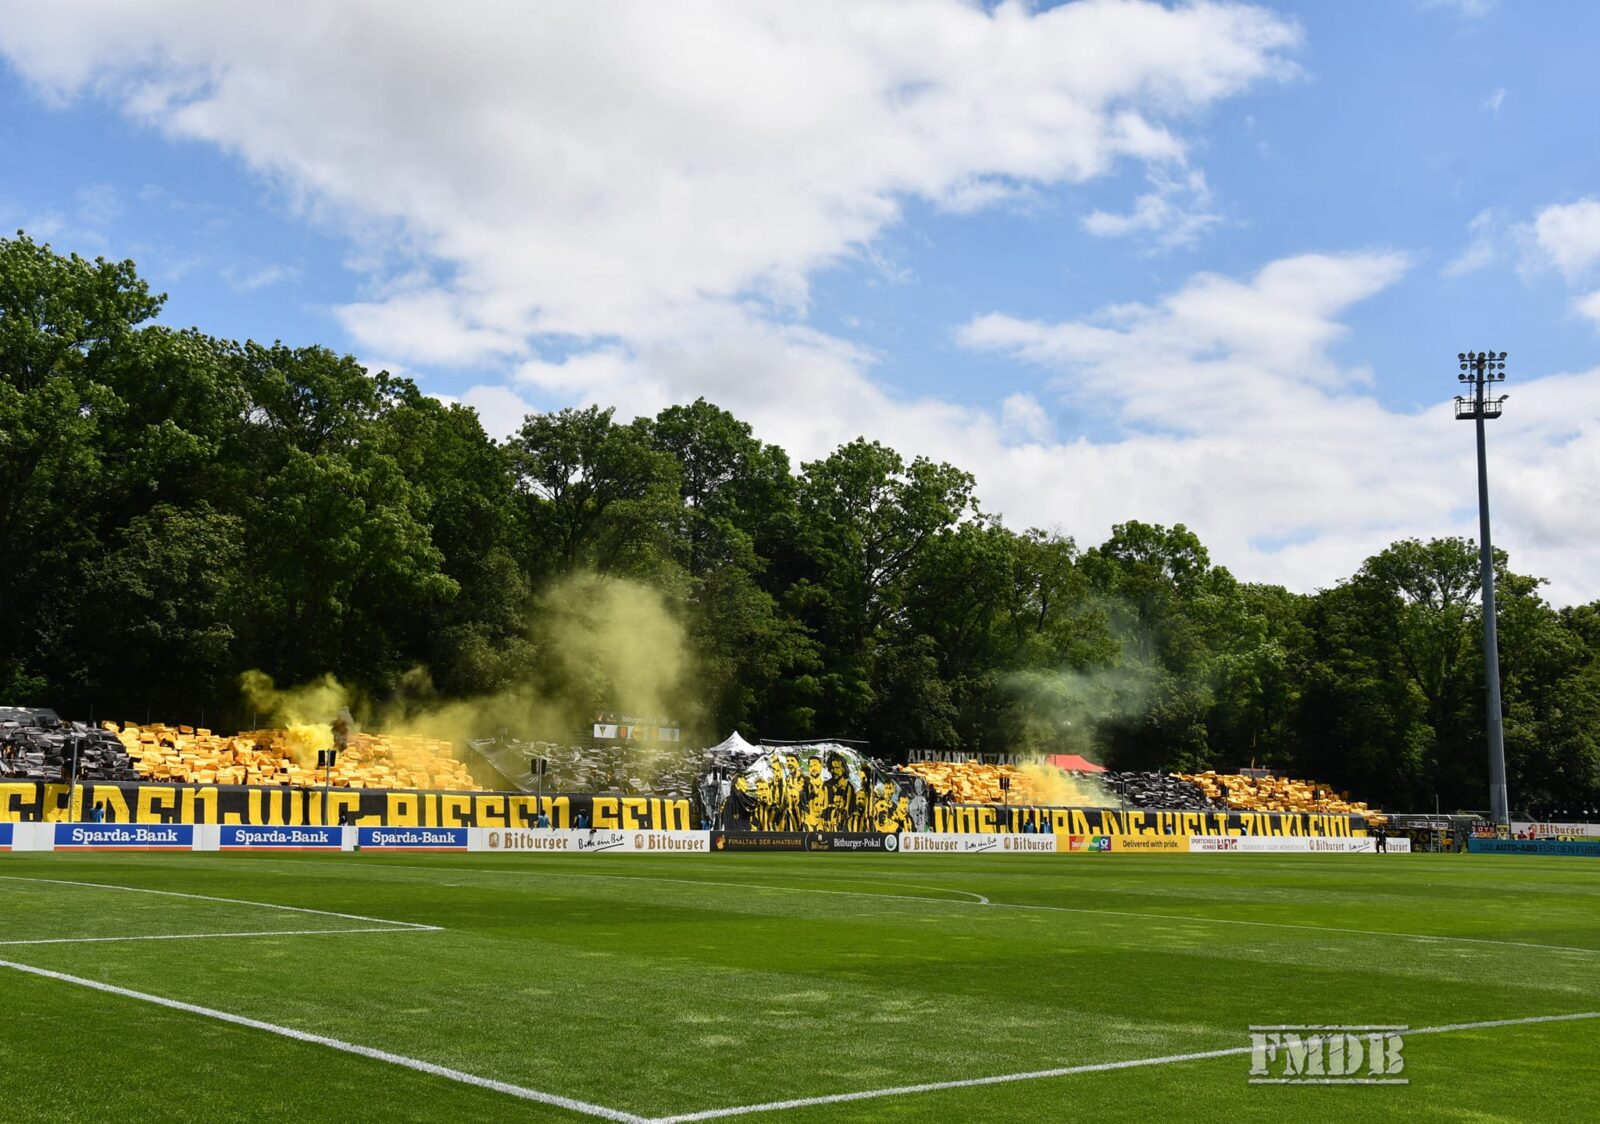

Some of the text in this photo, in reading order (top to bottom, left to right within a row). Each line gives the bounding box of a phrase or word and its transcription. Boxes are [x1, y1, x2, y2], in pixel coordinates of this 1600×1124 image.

[907, 749, 984, 765] ALEMANNIA
[73, 828, 178, 845] Sparda-Bank
[235, 829, 328, 844] Sparda-Bank
[1540, 824, 1585, 835] Bitburger
[372, 830, 456, 844] Sparda-Bank
[504, 832, 568, 849] Bitburger
[648, 834, 705, 850] Bitburger
[728, 838, 802, 846] FINALTAG DER AMATEURE
[834, 837, 881, 849] Bitburger-Pokal
[914, 835, 959, 850] Bitburger
[1013, 835, 1053, 851] Bitburger
[1122, 840, 1180, 849] Delivered with pride.
[1316, 839, 1344, 851] Bitburger
[1496, 842, 1538, 852] AUTO-ABO
